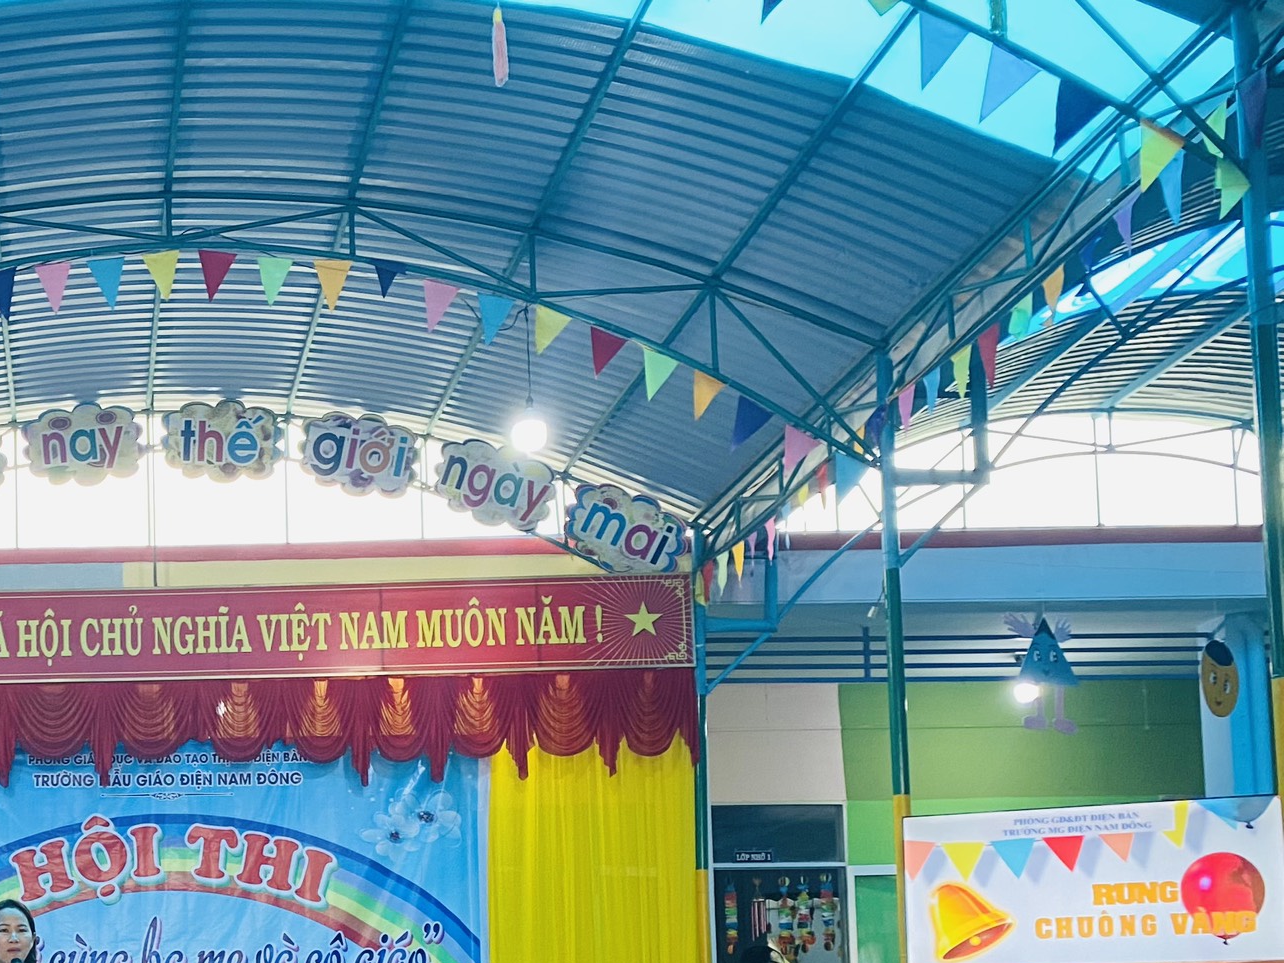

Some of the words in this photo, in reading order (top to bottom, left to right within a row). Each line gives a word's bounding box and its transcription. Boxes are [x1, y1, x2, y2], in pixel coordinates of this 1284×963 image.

[41, 423, 124, 470] nay
[180, 415, 265, 466] thế
[311, 424, 408, 479] giới
[439, 460, 551, 523] ngày
[581, 504, 676, 566] mai
[16, 607, 72, 667] HỘI
[79, 605, 144, 657] CHỦ
[152, 606, 252, 656] NGHĨA
[257, 602, 332, 662] VIỆT
[340, 610, 409, 651] NAM
[416, 597, 508, 649] MUÔN
[515, 595, 588, 647] NĂM
[74, 753, 95, 764] GIÁ
[186, 754, 208, 766] TẠO
[34, 770, 94, 787] TRƯỜNG
[136, 771, 174, 786] GIÁO
[180, 771, 213, 789] ĐIỆN
[218, 774, 252, 785] NAM
[256, 769, 302, 785] ĐÔNG
[1049, 826, 1065, 834] MG
[1095, 822, 1119, 832] NAM
[11, 816, 161, 902] HỘI
[187, 824, 334, 902] THI
[1092, 881, 1179, 905] RUNG
[1035, 910, 1157, 939] CHUÔNG
[1171, 906, 1257, 935] VÀNG
